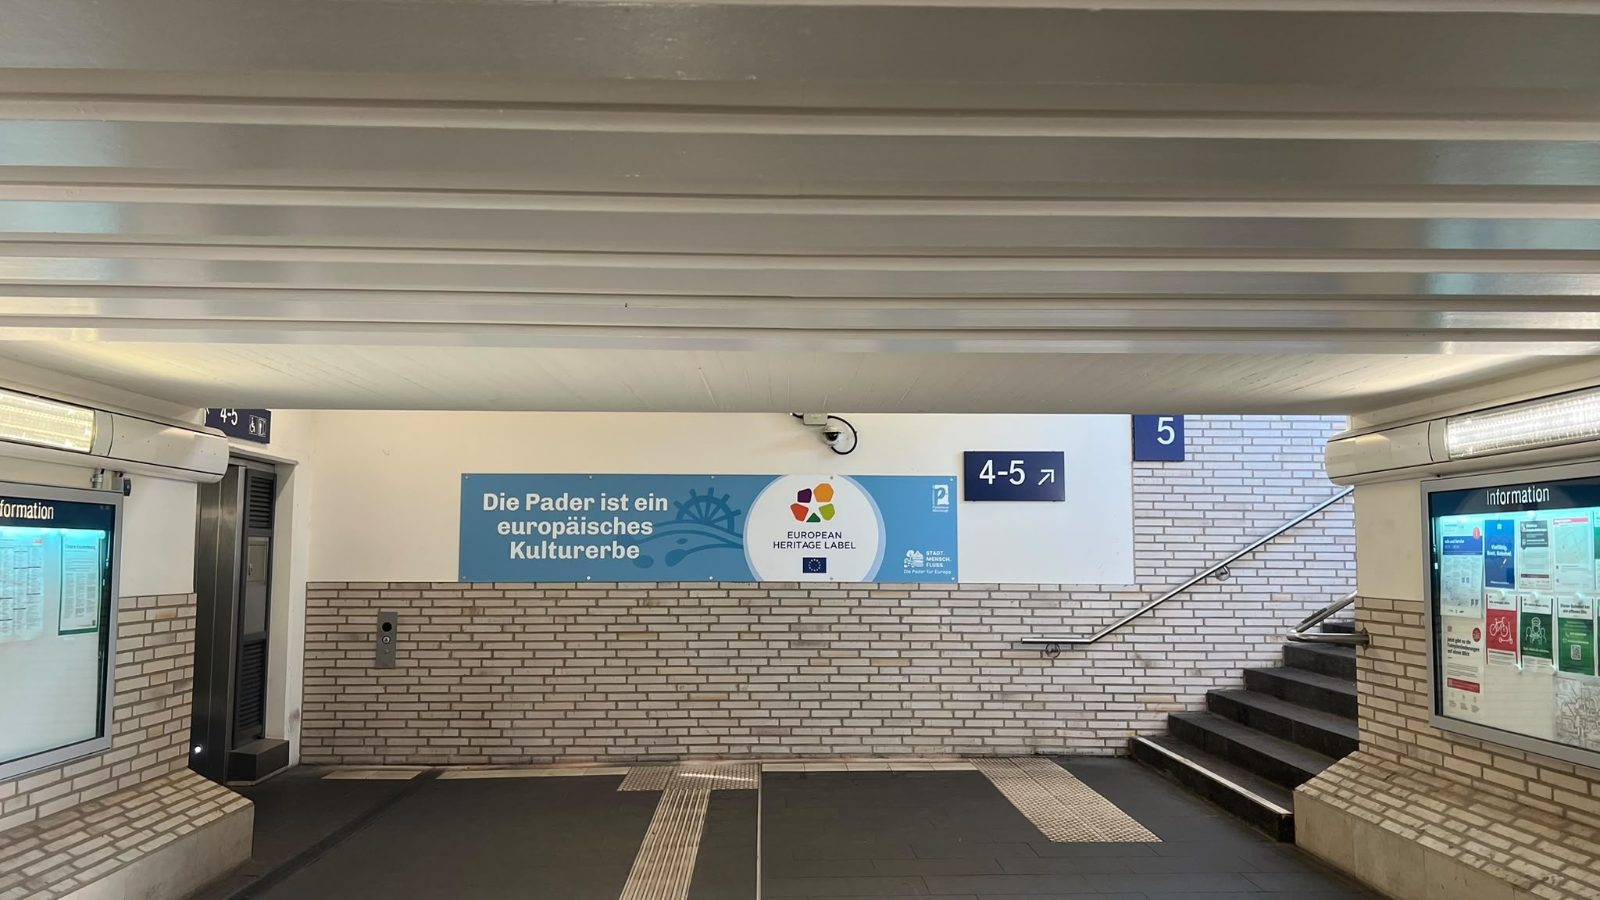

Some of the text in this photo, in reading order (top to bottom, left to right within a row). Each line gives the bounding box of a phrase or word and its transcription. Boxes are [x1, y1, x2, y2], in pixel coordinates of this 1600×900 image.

[1156, 416, 1176, 445] 5
[979, 459, 1026, 485] 4-5
[483, 492, 668, 511] Die Pader ist ein
[1486, 485, 1550, 506] Information
[497, 516, 653, 539] europäisches
[787, 531, 842, 539] EUROPEAN
[509, 541, 640, 560] Kulturerbe
[773, 541, 856, 549] HERITAGE LABEL
